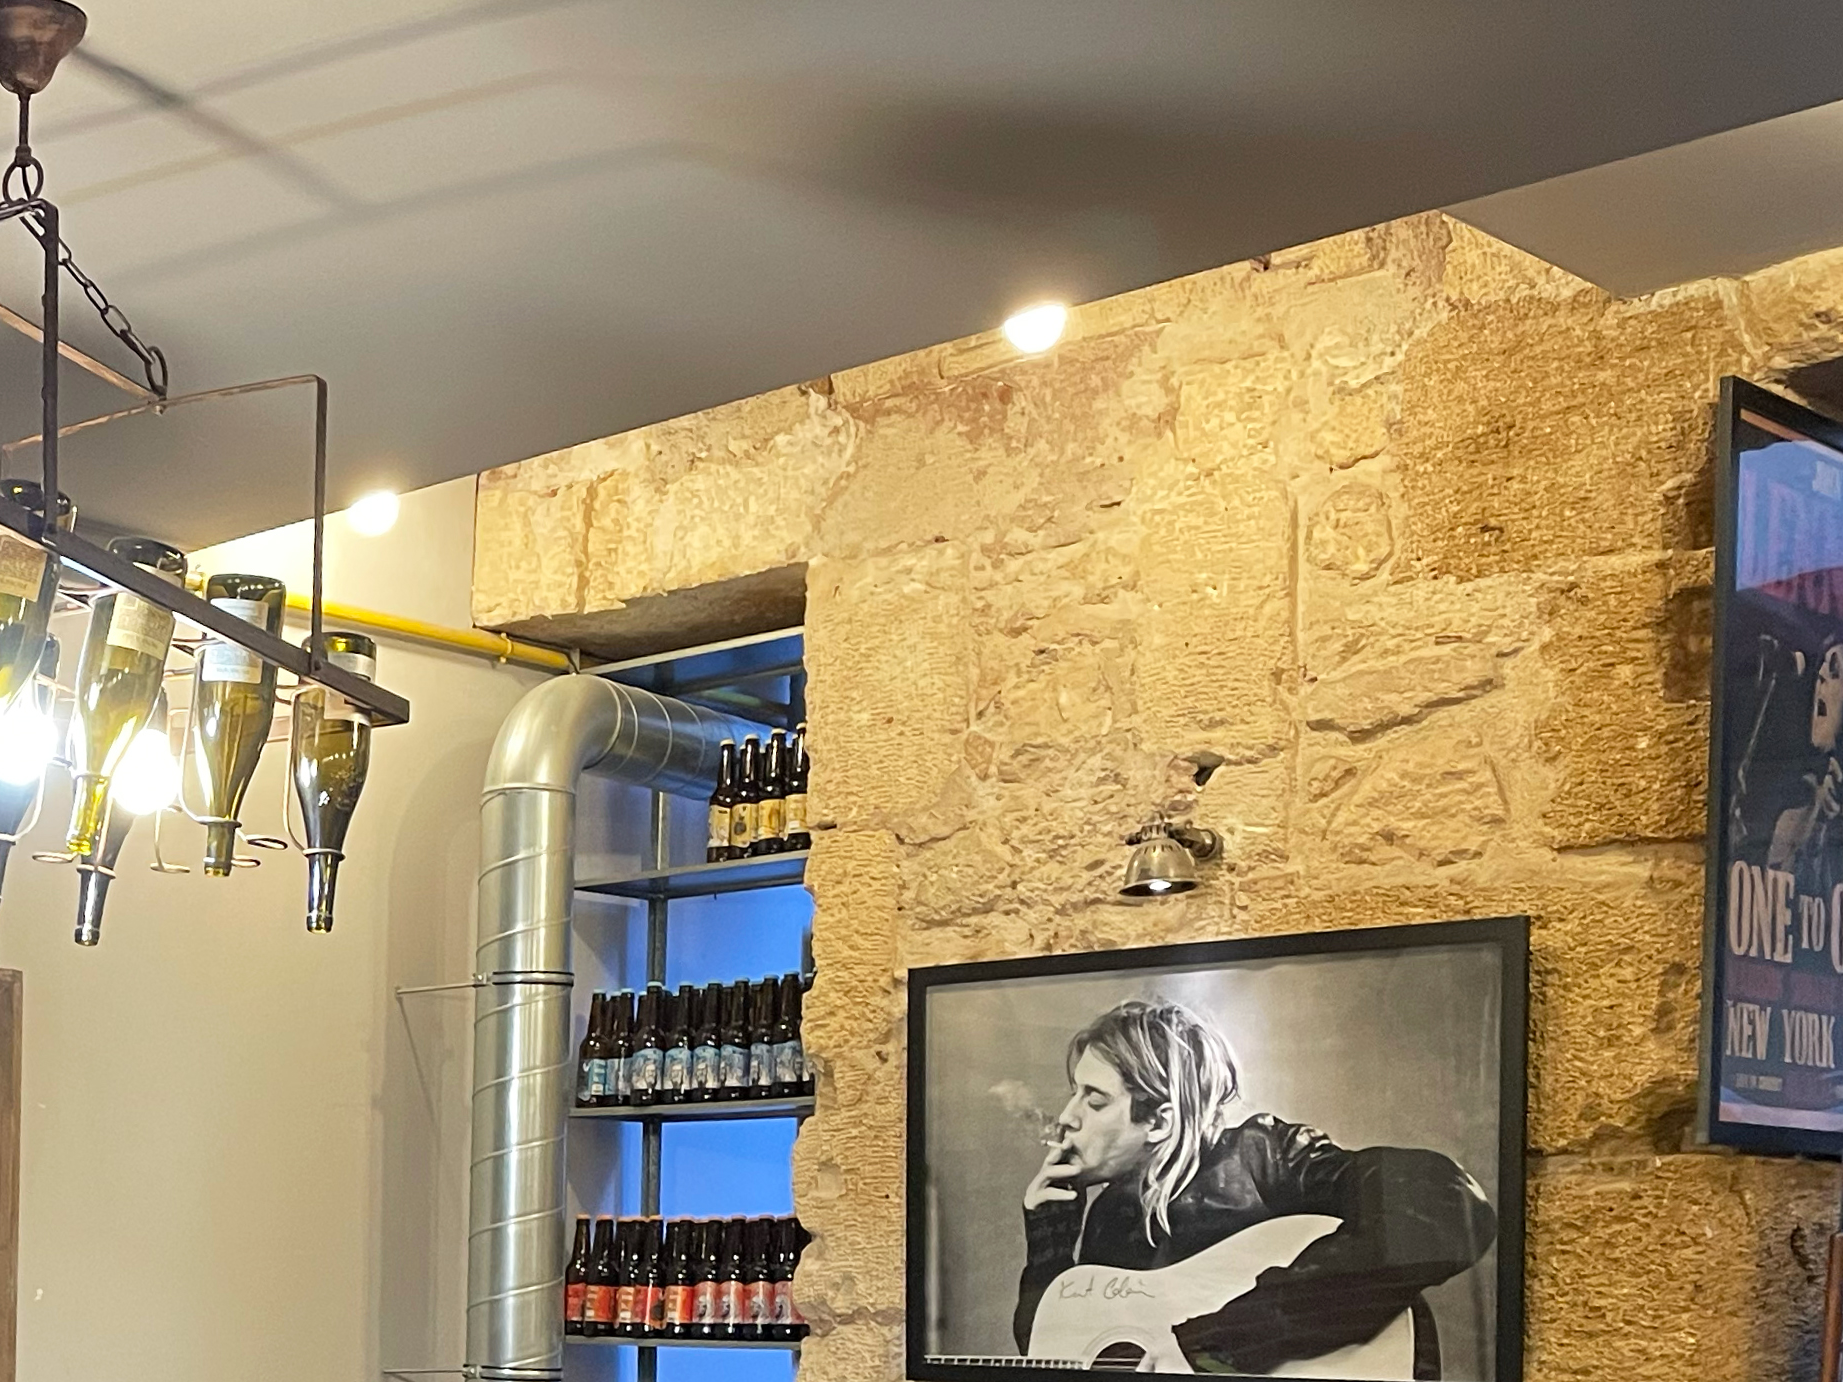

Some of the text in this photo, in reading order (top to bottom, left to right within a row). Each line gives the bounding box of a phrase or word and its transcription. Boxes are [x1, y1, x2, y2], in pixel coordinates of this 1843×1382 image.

[1729, 860, 1795, 964] ONE
[1799, 895, 1825, 952] TO
[1725, 1001, 1835, 1069] NEW YORK
